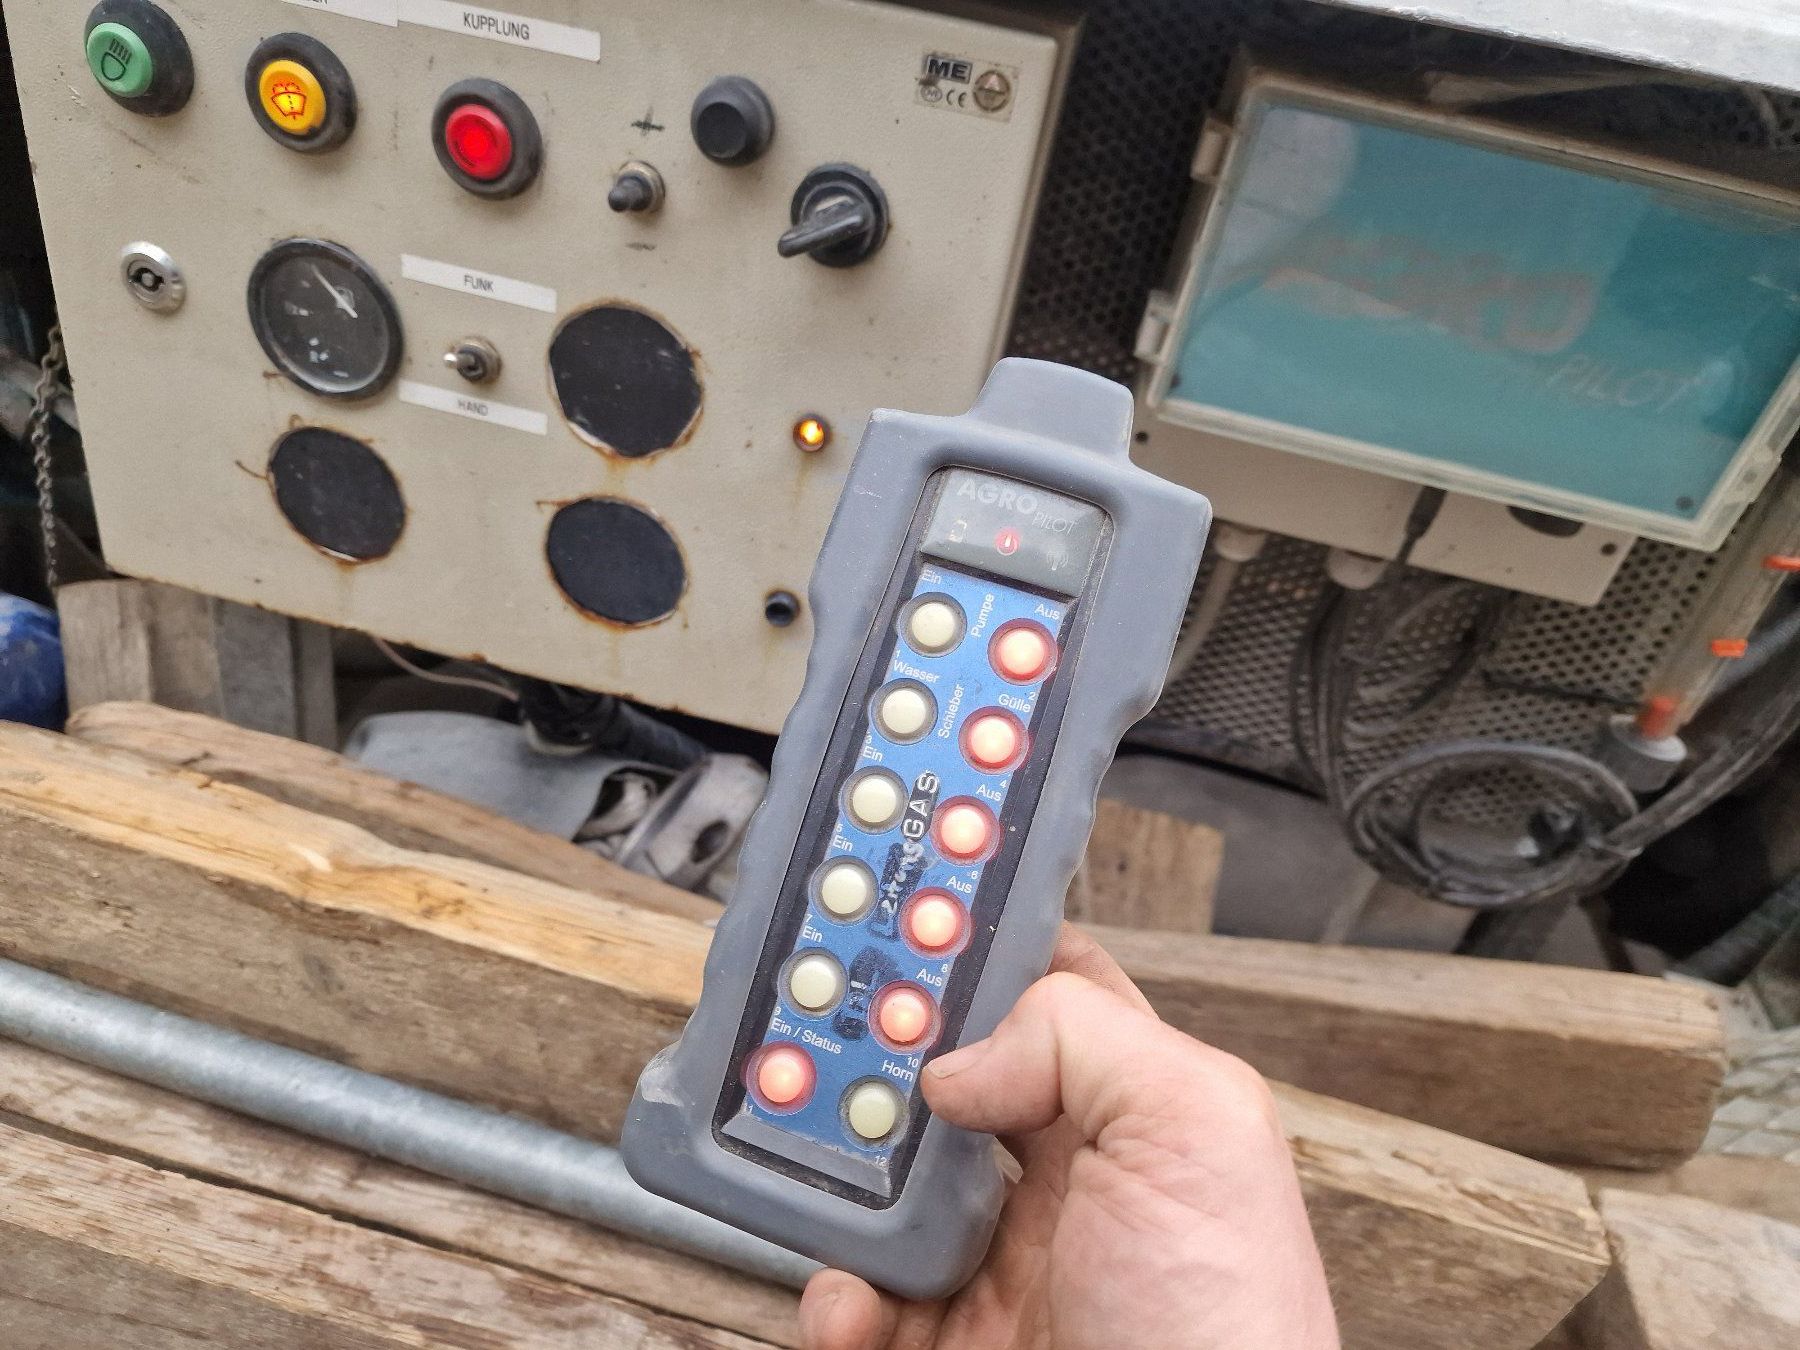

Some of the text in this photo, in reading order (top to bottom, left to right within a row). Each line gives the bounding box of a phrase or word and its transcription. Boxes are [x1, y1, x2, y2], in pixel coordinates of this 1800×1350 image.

[463, 12, 530, 40] KUPPLUNG
[928, 58, 968, 80] ME
[464, 275, 494, 292] FUNK
[457, 400, 489, 417] HAND
[957, 478, 1078, 534] AGRO PILOT
[921, 570, 941, 585] Ein
[971, 593, 995, 638] Pumpe
[1034, 603, 1060, 620] Aus
[893, 660, 941, 683] Wasser
[998, 693, 1031, 713] Gülle
[1028, 691, 1036, 701] 2
[937, 683, 965, 739] Schieber
[862, 746, 883, 762] Ein
[976, 783, 1002, 801] Aus
[1000, 779, 1007, 789] 4
[903, 771, 939, 839] GAS
[832, 835, 853, 852] Ein
[971, 870, 978, 880] 6
[947, 875, 973, 893] Aus
[805, 914, 813, 923] 7
[802, 926, 823, 943] Ein
[941, 963, 948, 973] 8
[916, 967, 943, 987] Aus
[774, 1006, 781, 1016] 9
[771, 1018, 792, 1036] Ein
[801, 1029, 842, 1054] Status
[882, 1059, 914, 1081] Horn
[907, 1056, 919, 1068] 10
[875, 1155, 887, 1166] 12
